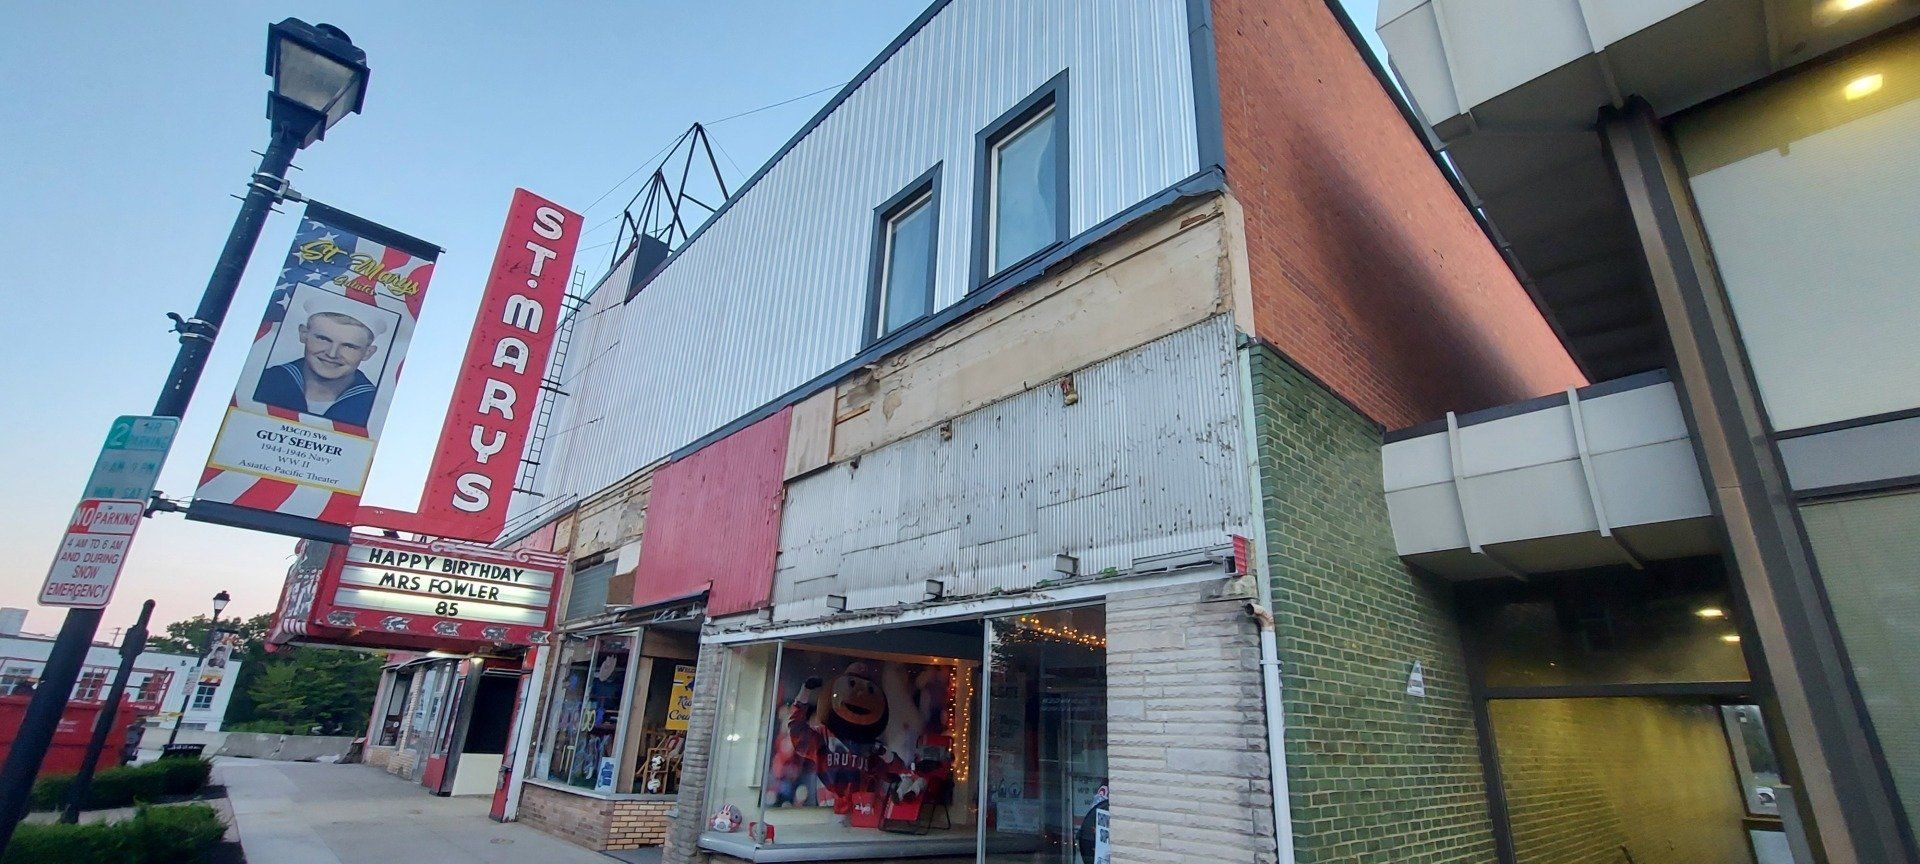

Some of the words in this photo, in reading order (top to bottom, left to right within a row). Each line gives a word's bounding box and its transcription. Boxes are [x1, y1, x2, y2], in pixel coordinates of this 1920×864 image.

[348, 252, 420, 296] Marys
[452, 293, 544, 512] MARYS
[108, 422, 130, 446] 2
[256, 429, 288, 444] GUY
[288, 436, 343, 456] SEEWER
[261, 443, 307, 459] 1944-1946
[308, 452, 332, 466] Navy
[239, 459, 304, 478] Asiatic-Pacific
[307, 472, 340, 485] Theater
[94, 512, 138, 526] PARKING
[67, 537, 74, 546] 4
[74, 538, 89, 548] AM
[89, 539, 100, 549] TO
[101, 539, 109, 549] 6
[110, 540, 123, 550] AM
[60, 551, 80, 562] AND
[83, 552, 119, 564] DURING
[368, 548, 437, 570] HAPPY
[441, 558, 524, 582] BIRTHDAY
[72, 565, 99, 579] SNOW
[46, 582, 109, 598] EMERGENCY
[378, 572, 421, 591] MRS
[428, 578, 500, 600] FOWLER
[434, 601, 459, 617] 85
